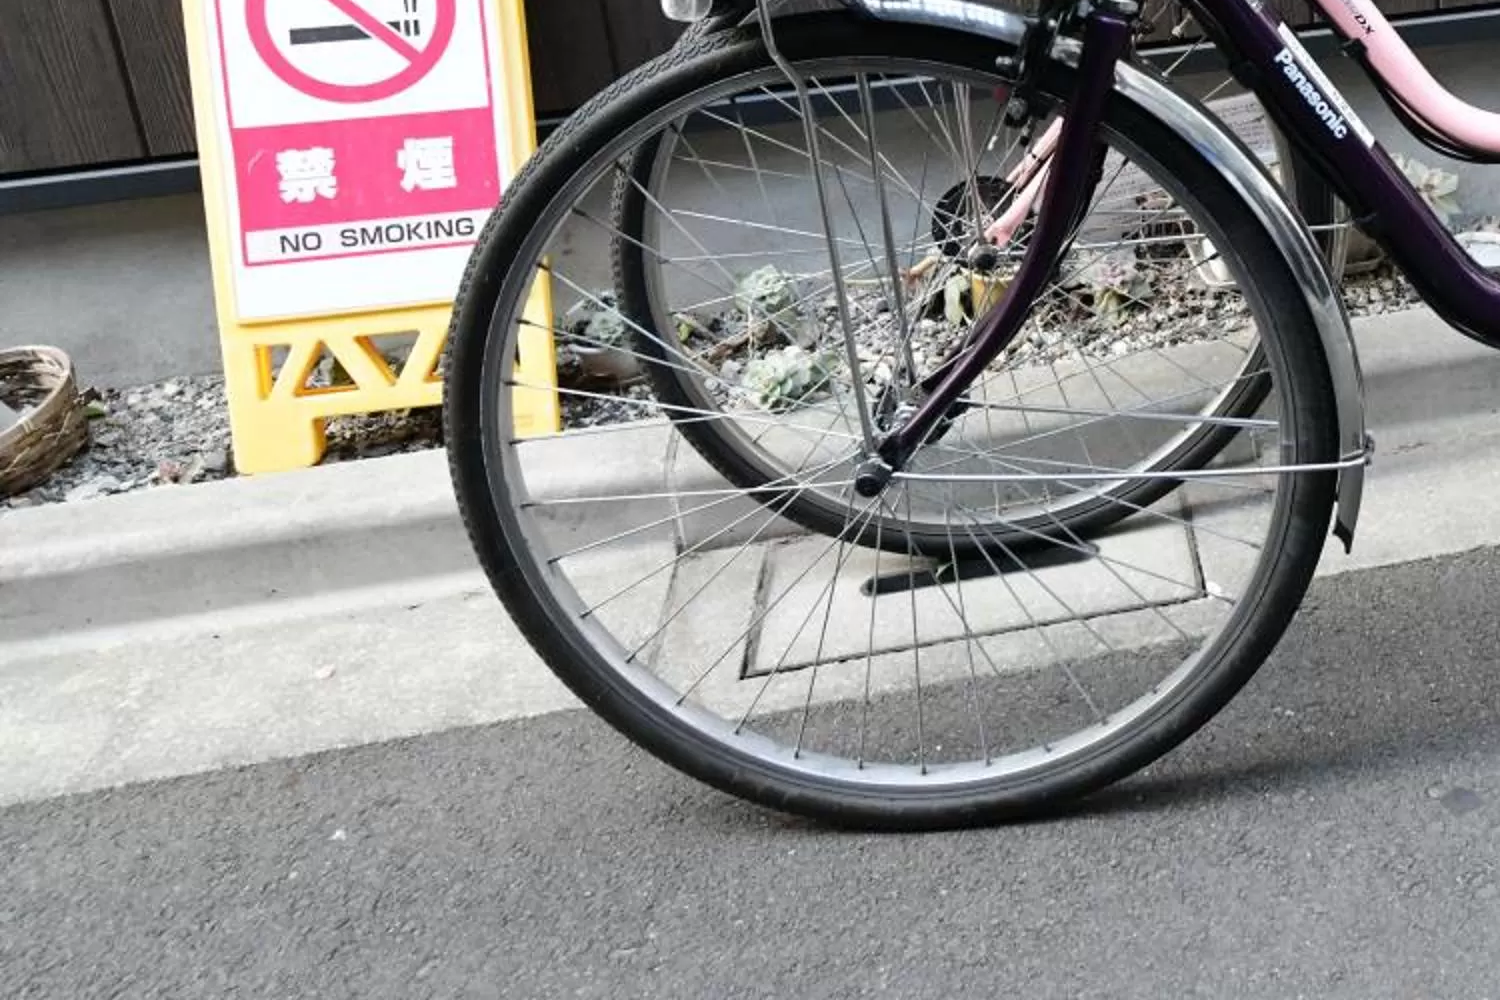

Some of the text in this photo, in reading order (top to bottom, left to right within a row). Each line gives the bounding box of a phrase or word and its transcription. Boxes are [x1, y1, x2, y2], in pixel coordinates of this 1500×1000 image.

[1274, 48, 1348, 140] Panasonic
[275, 136, 458, 204] 禁煙
[279, 217, 475, 253] NO SMOKING
